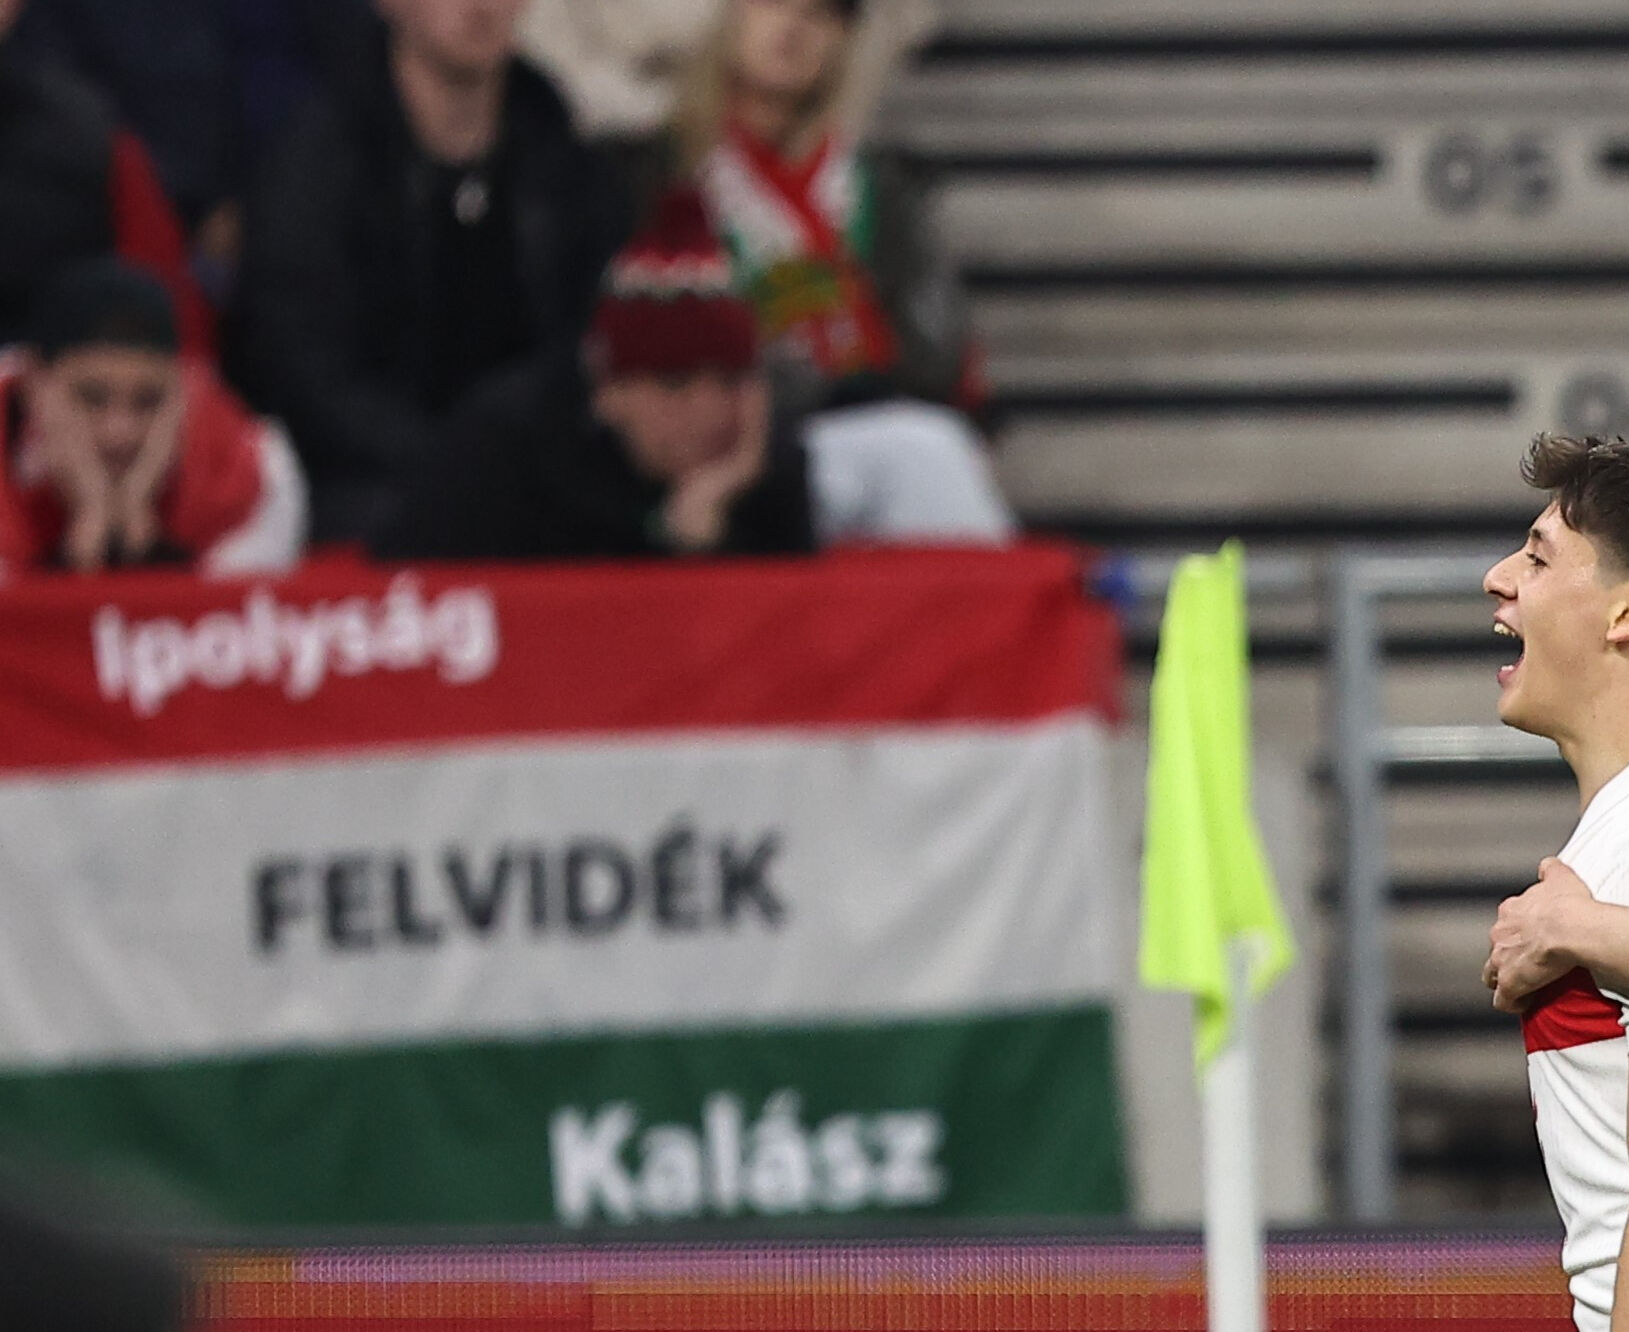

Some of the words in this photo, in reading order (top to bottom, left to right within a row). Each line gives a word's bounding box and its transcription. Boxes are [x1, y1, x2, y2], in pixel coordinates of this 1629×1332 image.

[95, 576, 498, 713] Ipolyság
[250, 817, 789, 957] FELVIDÉK
[550, 1088, 946, 1226] Kalász
